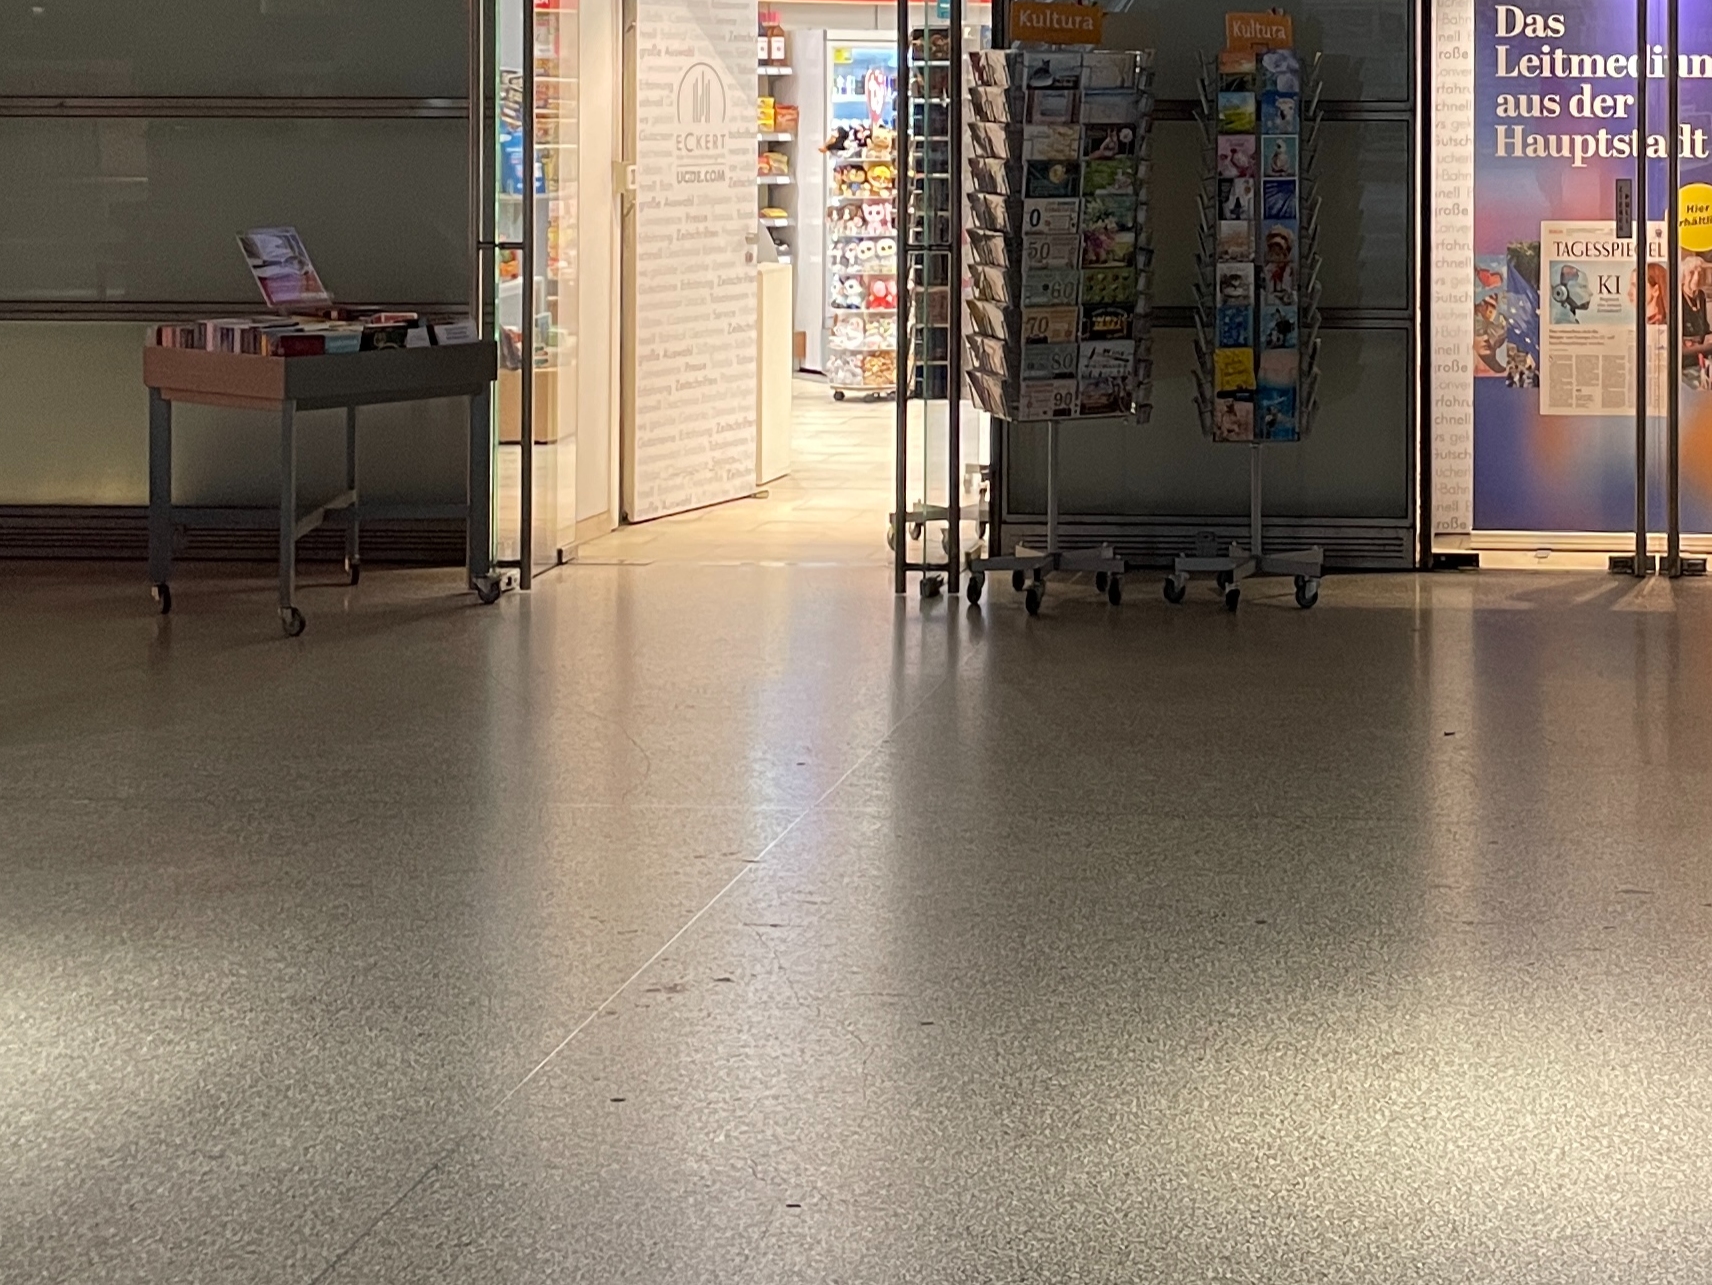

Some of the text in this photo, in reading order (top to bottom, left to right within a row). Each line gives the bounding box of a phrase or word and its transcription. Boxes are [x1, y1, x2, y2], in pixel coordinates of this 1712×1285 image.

[1018, 9, 1094, 31] Kultura
[1232, 19, 1287, 40] Kultura
[1494, 4, 1565, 38] Das
[1496, 83, 1635, 118] aus der
[675, 132, 727, 153] ECKERT
[1686, 203, 1710, 214] Hier
[1027, 241, 1051, 260] 50
[1552, 240, 1666, 258] TAGESSPIEEL
[1050, 280, 1075, 299] 60
[1597, 274, 1622, 296] KI
[1027, 315, 1050, 334] 70
[1053, 391, 1073, 408] 90
